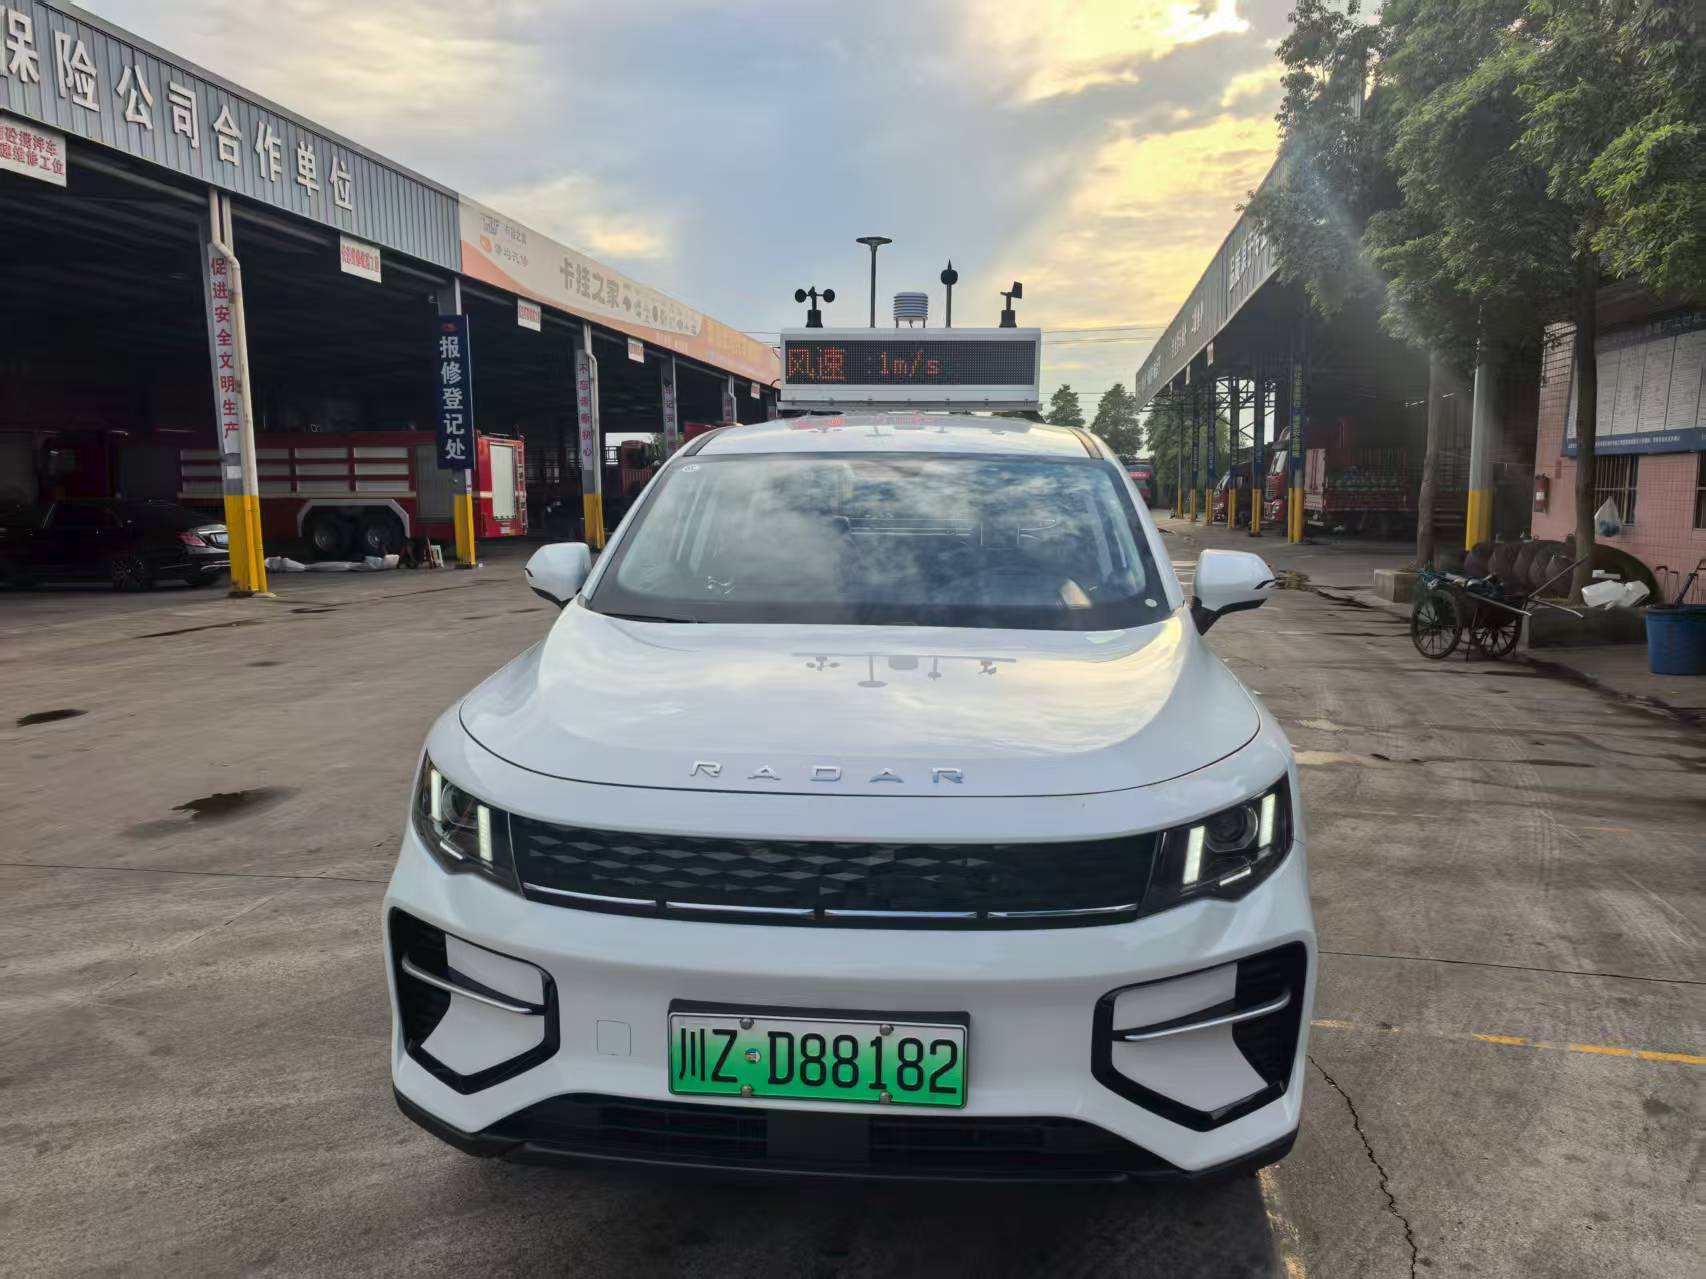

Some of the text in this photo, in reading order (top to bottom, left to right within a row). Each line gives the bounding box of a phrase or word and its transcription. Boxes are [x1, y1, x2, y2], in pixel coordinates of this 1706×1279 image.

[0, 5, 353, 211] 保险公司合作单位
[210, 256, 240, 439] 促进安全文明生产
[439, 335, 466, 461] 报修登记处
[786, 347, 846, 381] 风速
[689, 760, 964, 785] RADAR
